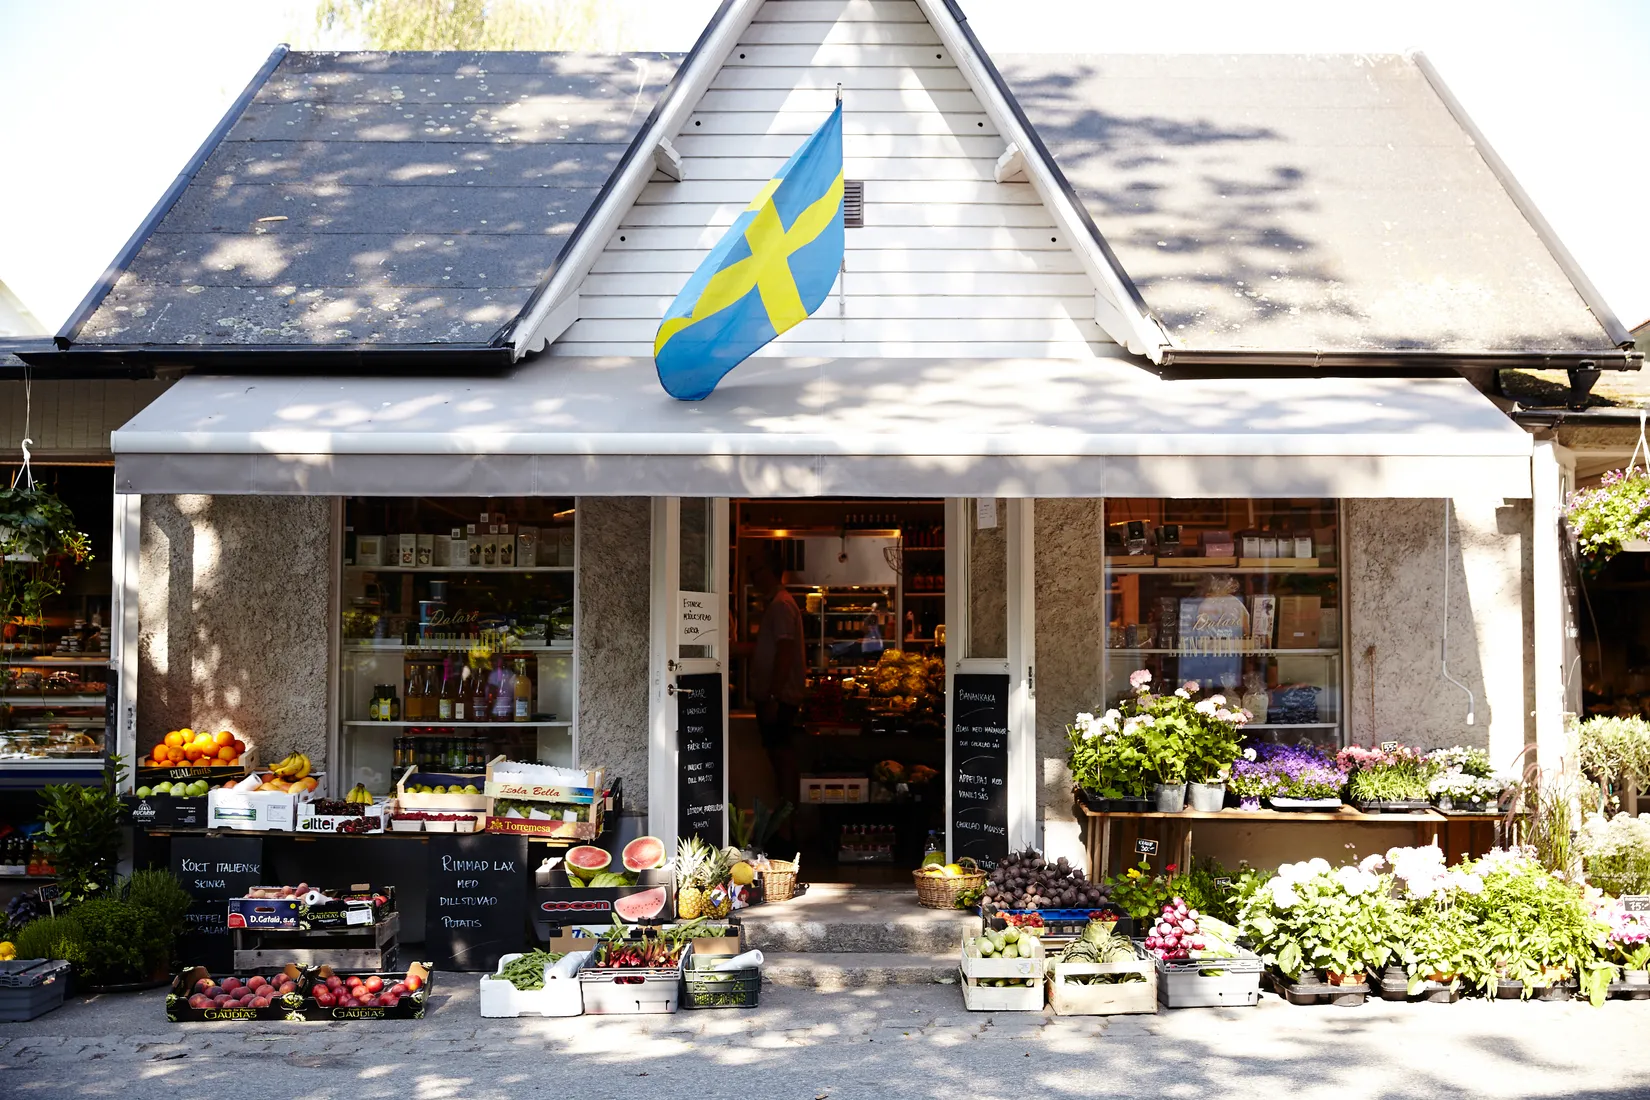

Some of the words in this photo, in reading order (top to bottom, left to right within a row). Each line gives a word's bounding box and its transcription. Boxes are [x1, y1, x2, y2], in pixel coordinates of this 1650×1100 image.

[404, 632, 511, 654] LANTHANDEL
[1168, 635, 1277, 658] LANTHANDEL
[959, 688, 996, 704] BANANKAKA
[500, 784, 528, 795] Isola
[532, 786, 561, 797] Bella
[302, 817, 335, 830] alttei
[504, 820, 551, 833] Torremesa
[955, 820, 980, 831] CHOKLAD
[983, 823, 1005, 836] MOUSSE
[181, 858, 211, 873] KOKT
[216, 862, 260, 874] ITALIENSK
[441, 854, 489, 871] RIMMAD
[493, 860, 516, 873] LAX
[194, 879, 226, 889] SKINKA
[457, 879, 479, 888] MED
[439, 896, 498, 906] DILLSTUVAD
[541, 900, 611, 912] cocon
[184, 913, 225, 924] TRYFFEL
[441, 915, 482, 928] POTATIS
[204, 1008, 258, 1019] GAUDIAS
[332, 1008, 385, 1019] GAUDIAS
